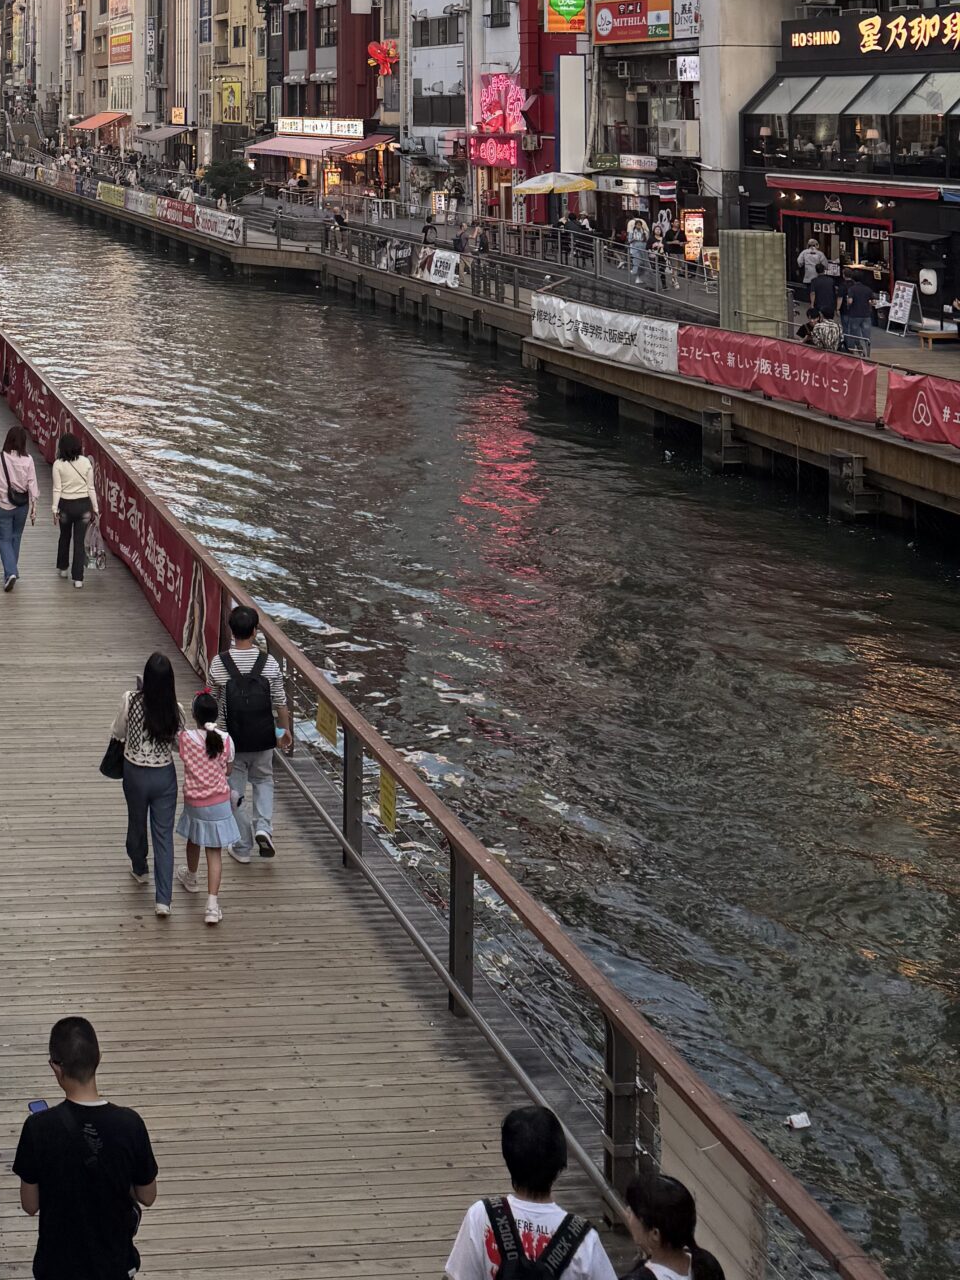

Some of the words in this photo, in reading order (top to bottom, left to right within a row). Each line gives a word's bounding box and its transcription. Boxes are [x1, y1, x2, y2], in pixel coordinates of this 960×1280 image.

[612, 16, 647, 28] MITHILA
[791, 30, 841, 47] HOSHINO
[678, 345, 850, 397] エアビーで、新しい大阪を見つけにいこう
